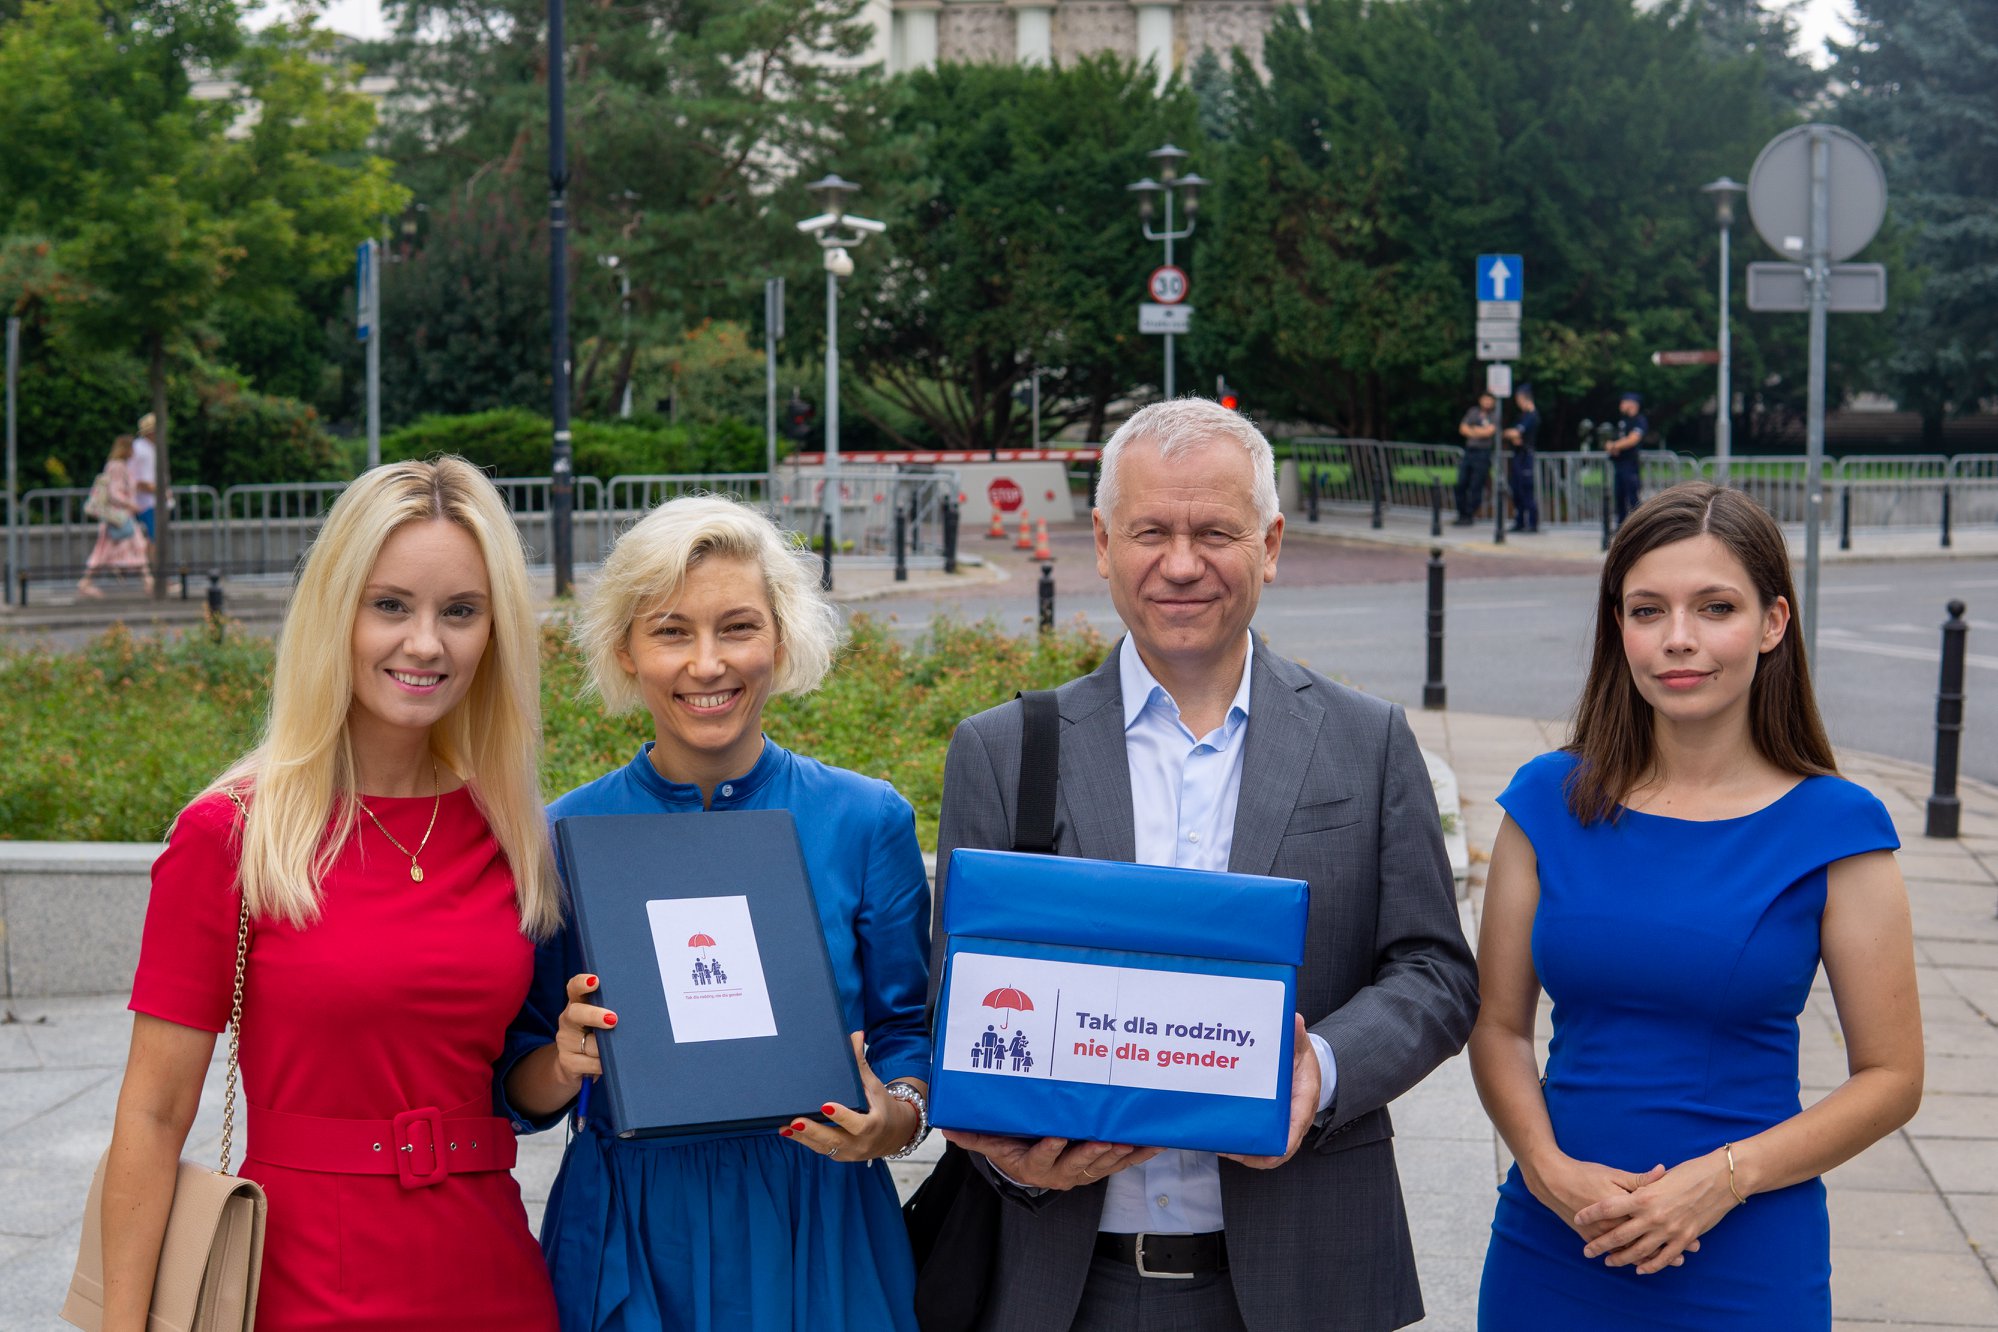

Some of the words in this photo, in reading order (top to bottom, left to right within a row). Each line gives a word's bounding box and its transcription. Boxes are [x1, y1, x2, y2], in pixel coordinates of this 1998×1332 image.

[1155, 277, 1182, 296] 30
[991, 487, 1019, 502] STOP
[1075, 1011, 1118, 1032] Tak
[1123, 1016, 1158, 1035] dla
[1165, 1022, 1256, 1047] rodziny,
[1073, 1038, 1109, 1058] nie
[1115, 1042, 1150, 1062] dla
[1156, 1050, 1240, 1070] gender
